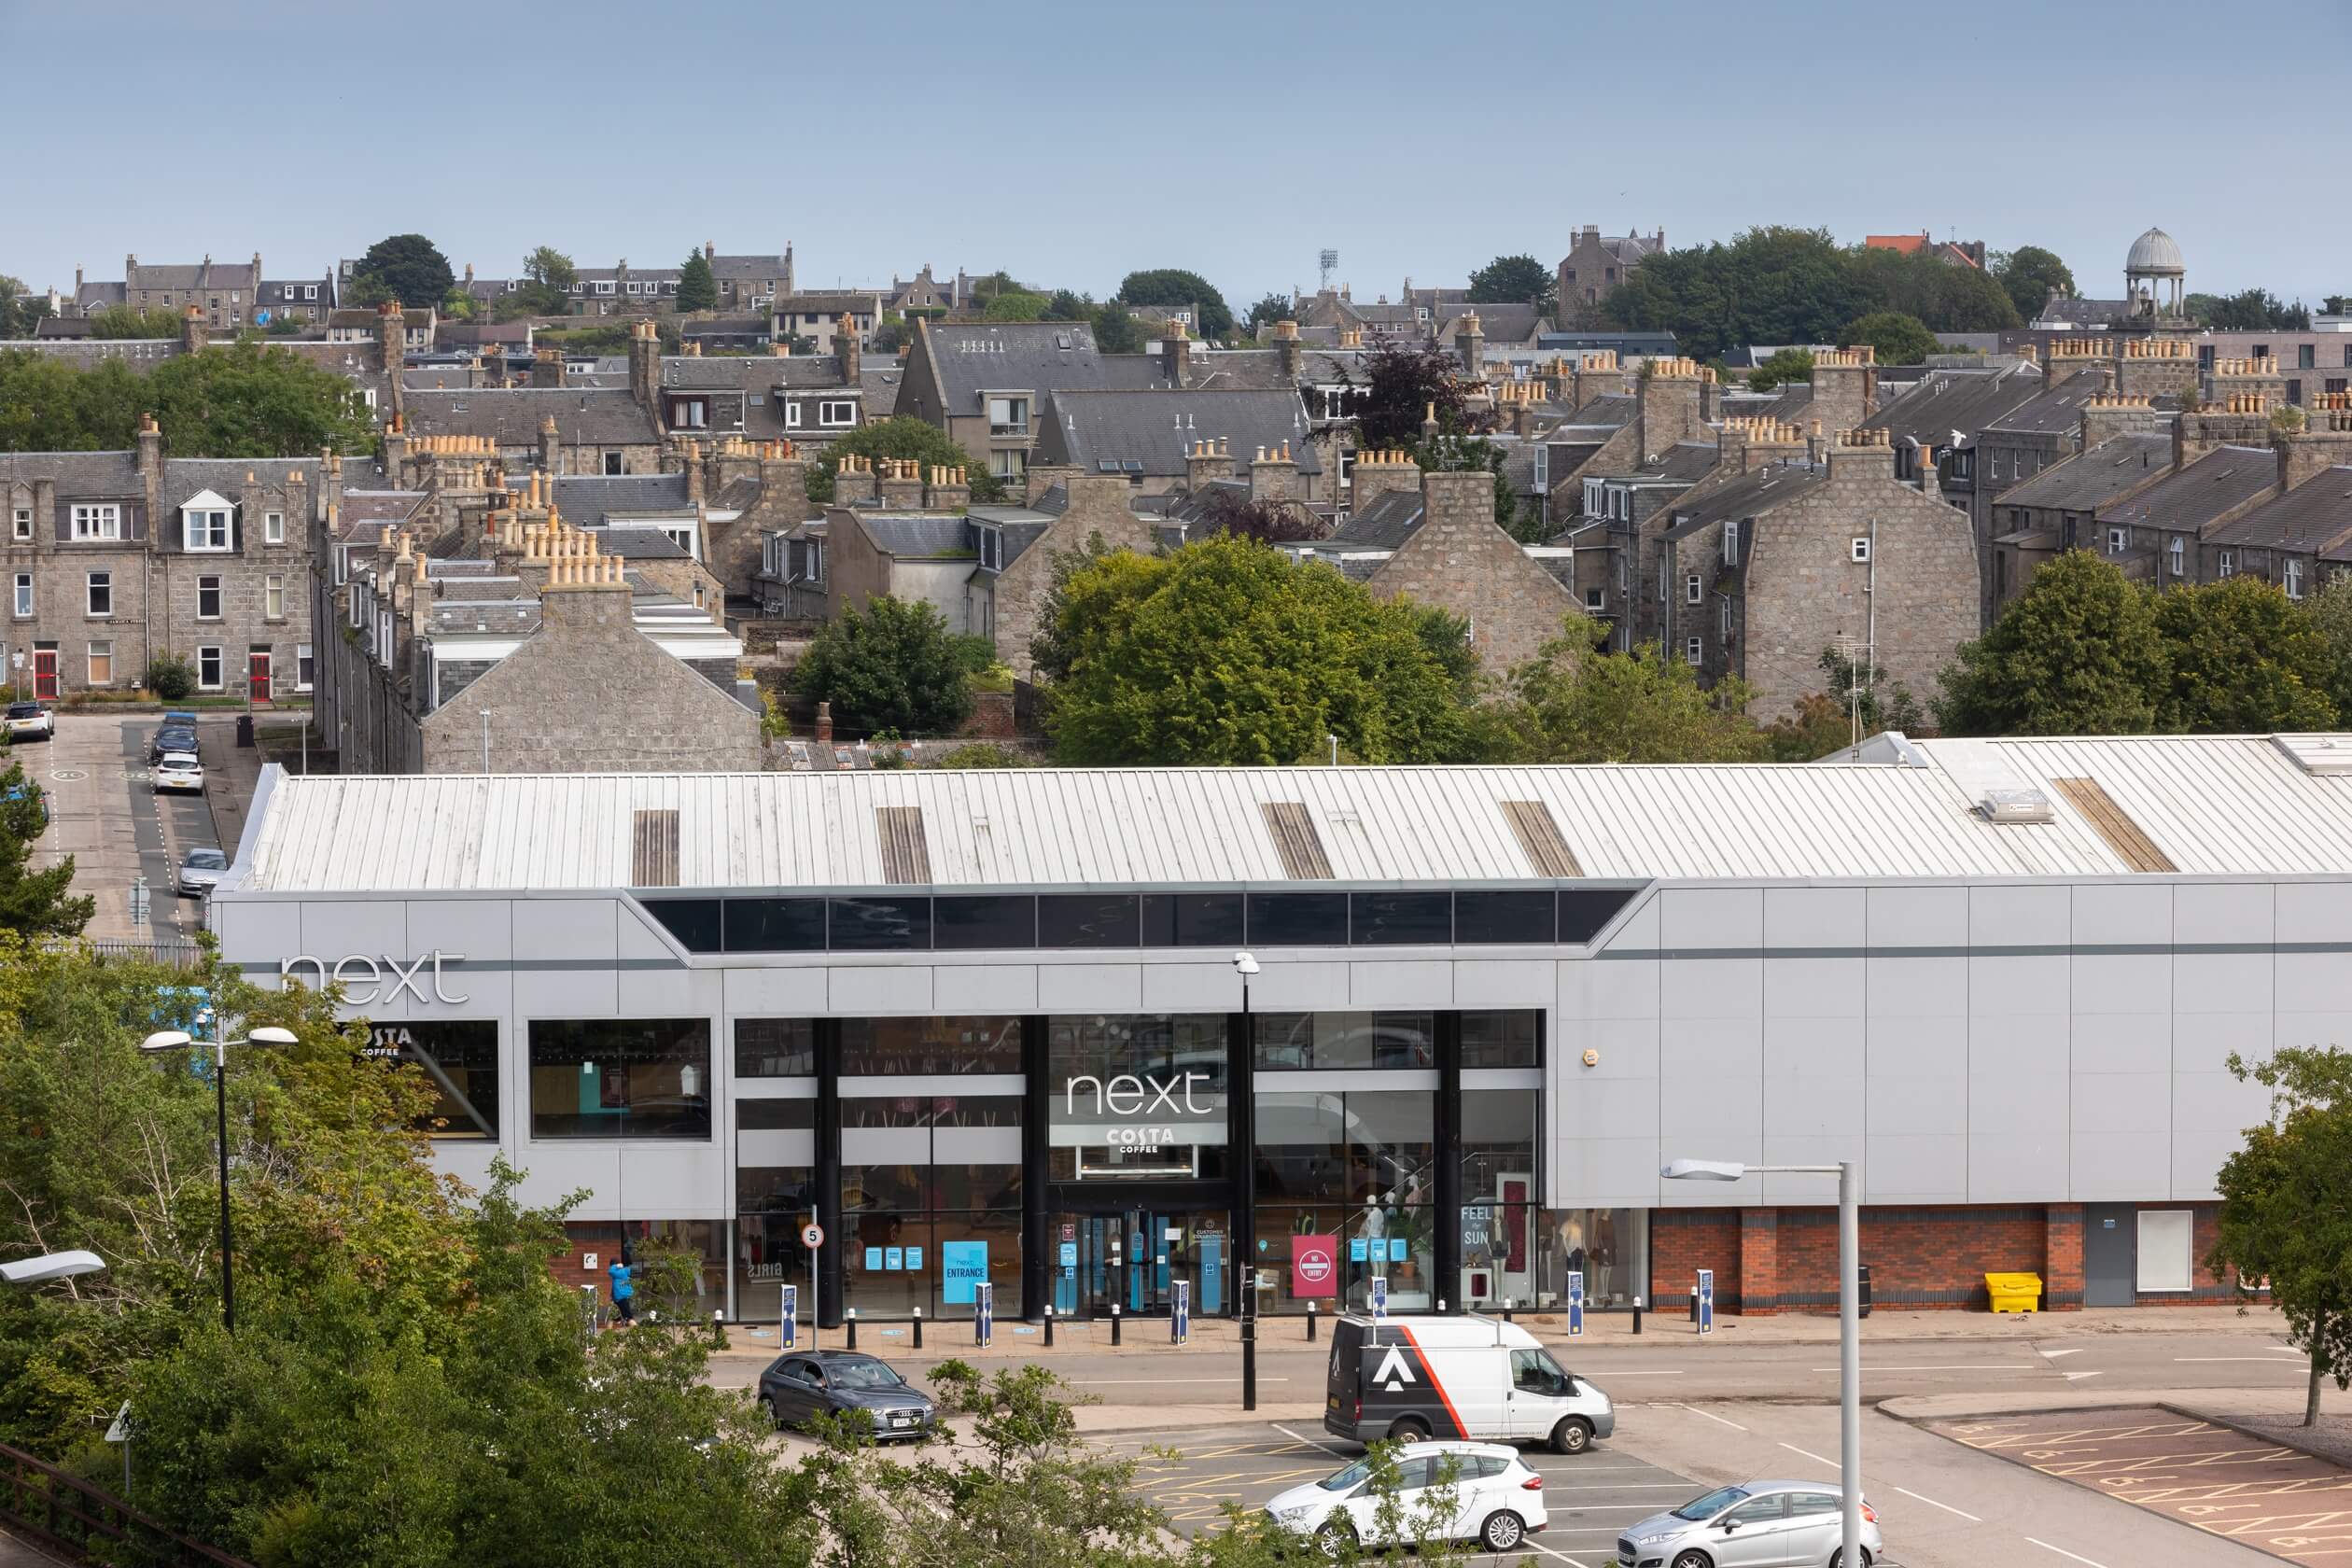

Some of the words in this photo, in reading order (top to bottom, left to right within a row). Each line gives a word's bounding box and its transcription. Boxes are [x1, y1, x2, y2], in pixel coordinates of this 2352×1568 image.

[281, 949, 469, 1005] next
[1067, 1071, 1212, 1114] next
[1106, 1127, 1174, 1145] COSTA
[1120, 1145, 1158, 1154] COFFEE
[1461, 1206, 1491, 1220] FEEL
[809, 1230, 817, 1241] 5
[1464, 1231, 1489, 1244] SUN
[946, 1267, 985, 1278] ENTRANCE
